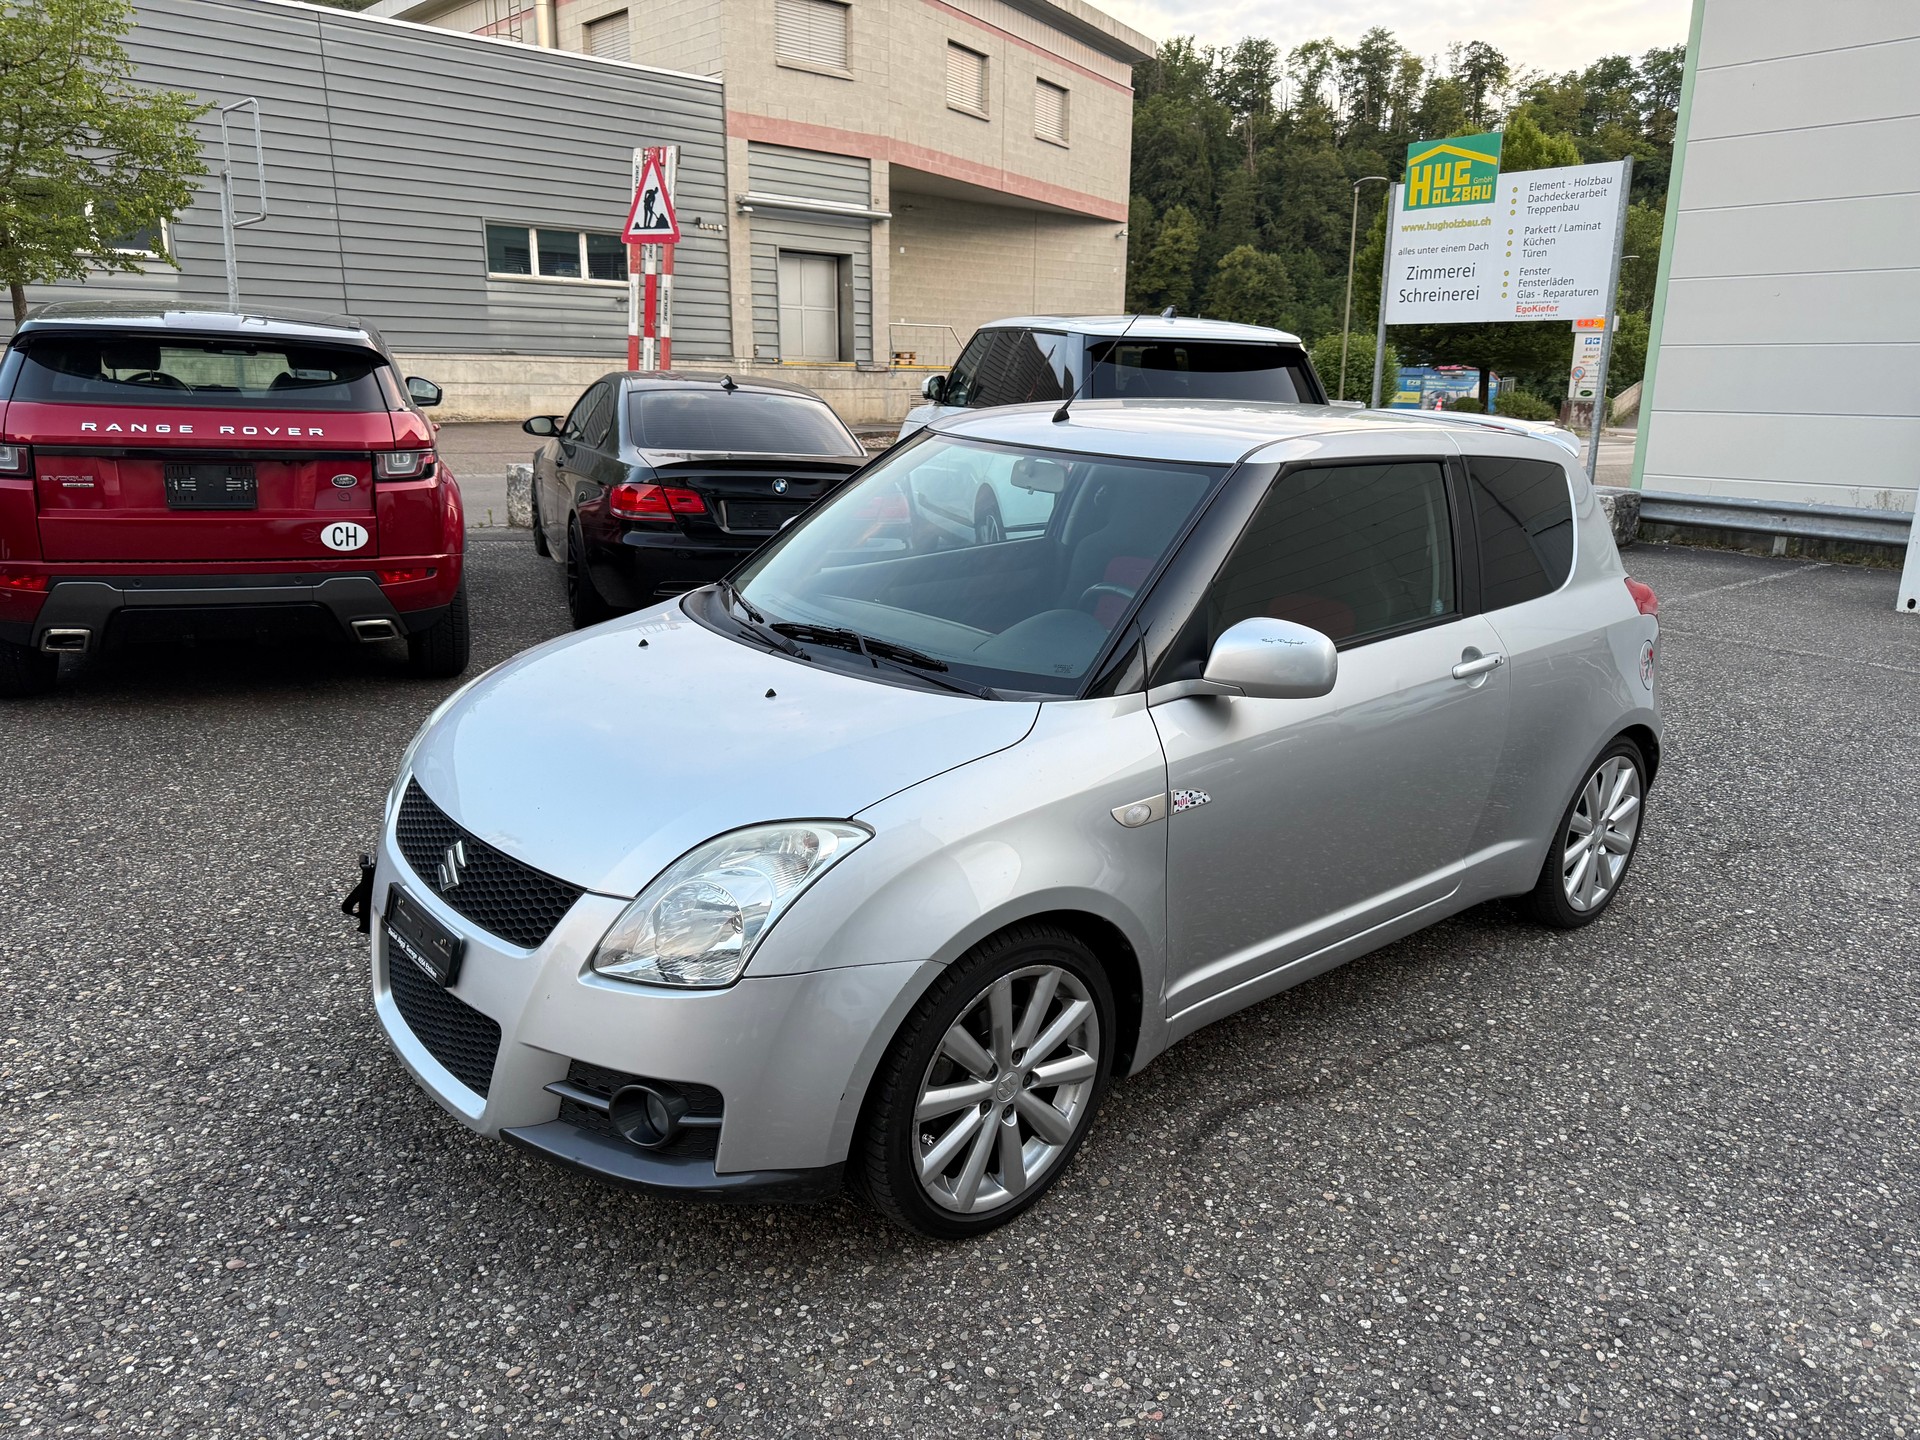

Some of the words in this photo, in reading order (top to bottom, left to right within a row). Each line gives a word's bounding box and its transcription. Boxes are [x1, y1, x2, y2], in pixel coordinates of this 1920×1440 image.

[1409, 160, 1471, 206] HUG
[1473, 176, 1492, 184] GmbH
[1529, 181, 1565, 191] Element
[1574, 176, 1613, 187] Holzbau
[1528, 189, 1607, 203] Dachdeckerarbeit
[1527, 203, 1580, 216] Treppenbau
[1401, 218, 1491, 232] www.hugholzbau.ch
[1524, 225, 1556, 235] Parkett
[1564, 222, 1601, 232] Laminat
[1523, 236, 1556, 246] Küchen
[1398, 246, 1415, 256] alles
[1417, 245, 1438, 254] unter
[1440, 244, 1466, 253] einem
[1468, 242, 1489, 251] Dach
[1522, 248, 1547, 258] Türen
[1406, 263, 1475, 280] Zimmerei
[1519, 267, 1551, 276] Fenster
[1518, 277, 1574, 287] Fensterläden
[1399, 286, 1480, 303] Schreinerei
[1517, 289, 1534, 299] Glas
[1543, 288, 1598, 299] Reparaturen
[1516, 305, 1559, 314] EgoKiefer
[81, 422, 194, 434] RANGE
[220, 426, 324, 436] ROVER
[333, 526, 357, 546] CH
